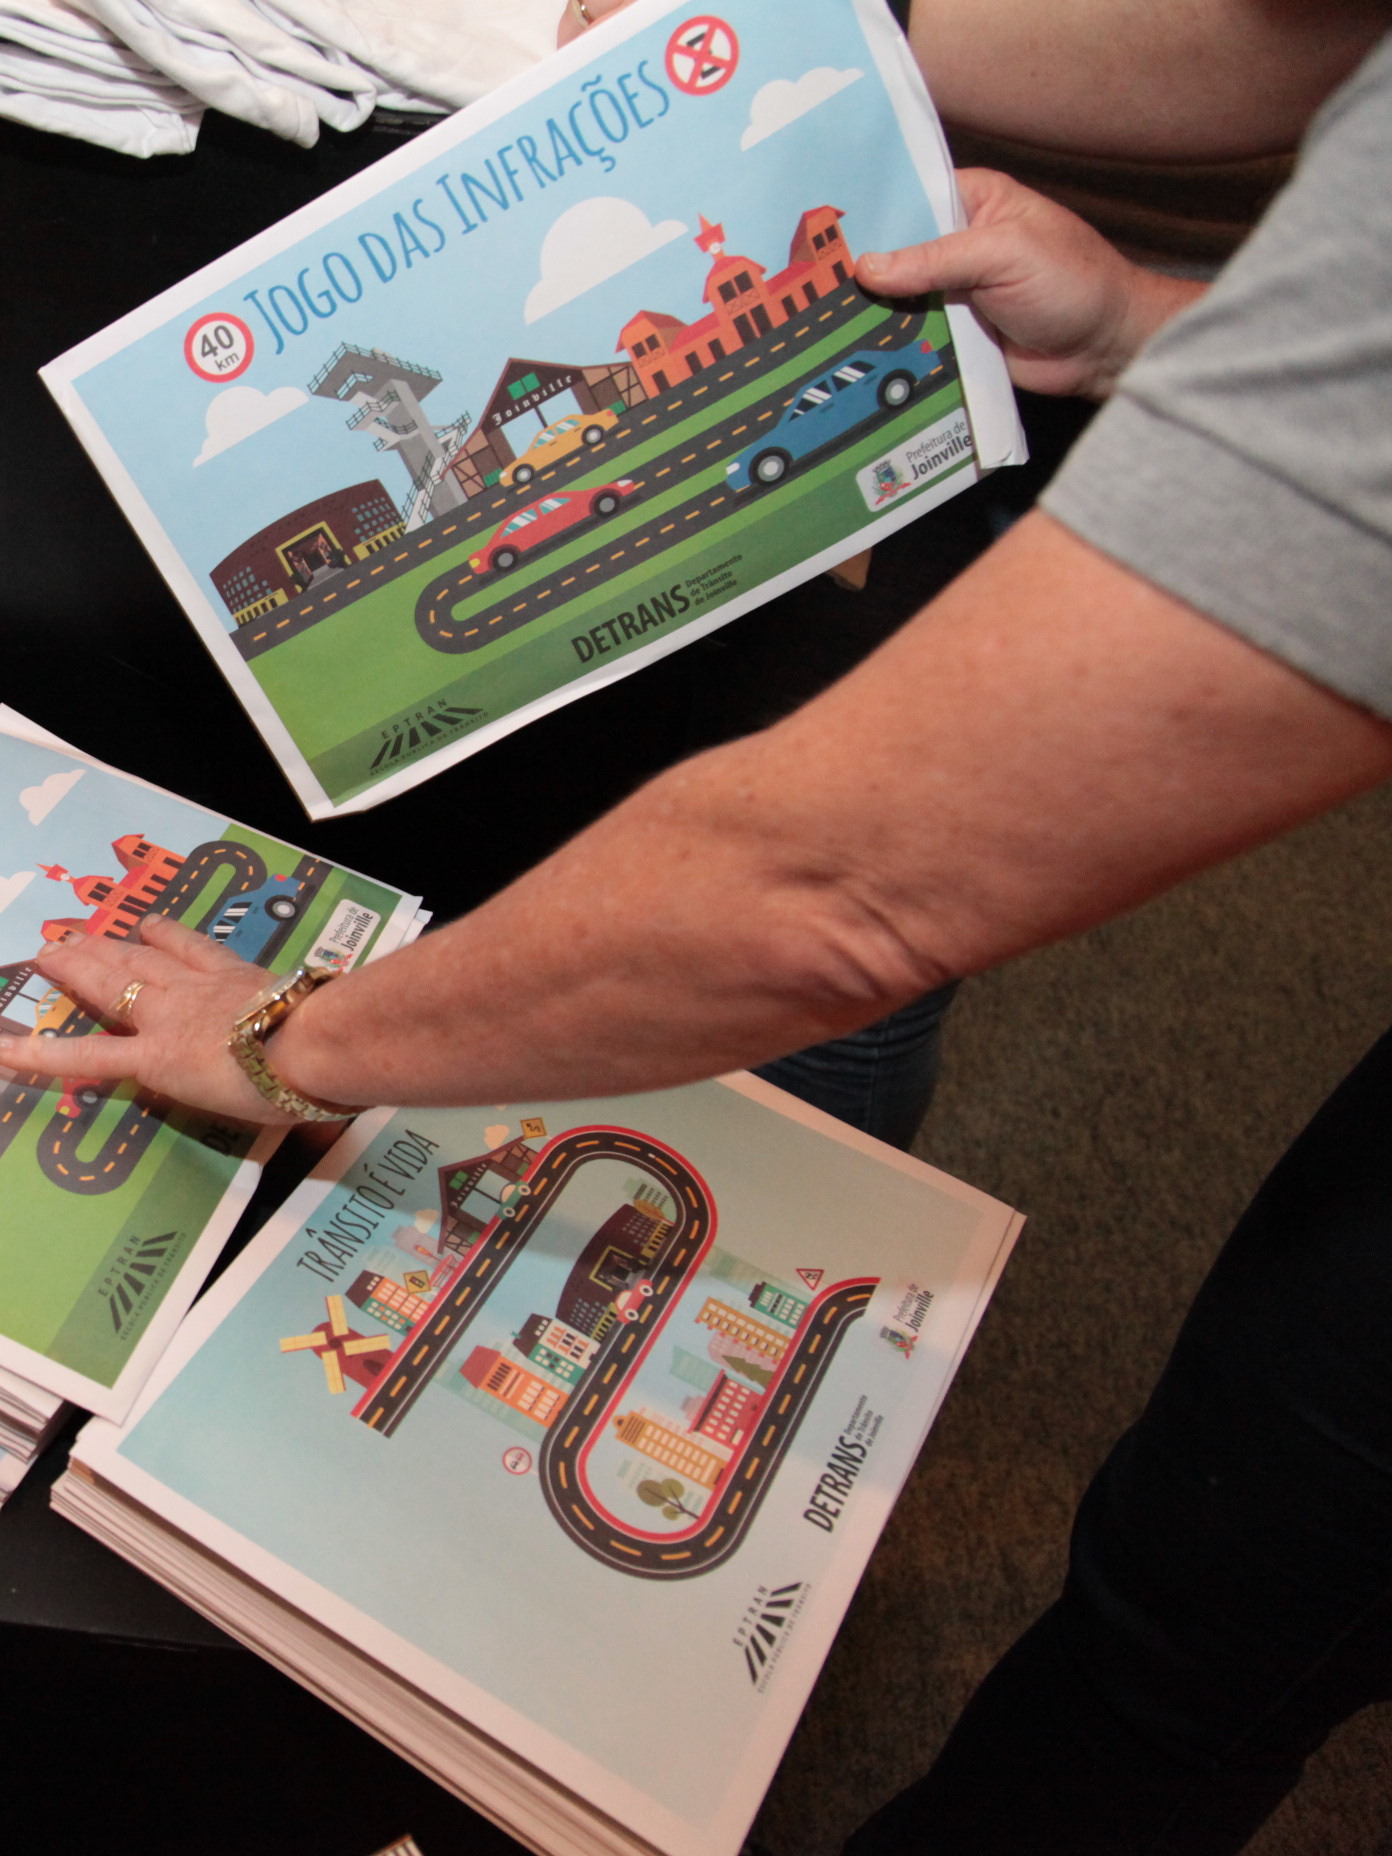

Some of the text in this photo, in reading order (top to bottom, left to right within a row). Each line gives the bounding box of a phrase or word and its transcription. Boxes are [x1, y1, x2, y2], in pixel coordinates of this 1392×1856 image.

[243, 60, 670, 355] JOGO DAS INFRAÇÕES
[200, 324, 235, 359] 40
[214, 350, 240, 372] km
[906, 420, 967, 463] Prefeitura de
[911, 434, 973, 480] Joinville
[685, 554, 743, 588] Departamento
[690, 571, 733, 597] de Trânsito
[695, 579, 737, 606] de Joinville
[570, 584, 691, 664] DETRANS
[381, 698, 447, 739] EPTRAN
[329, 906, 359, 944] Prefeitura de
[340, 911, 374, 952] Joinville
[296, 1128, 441, 1283] TRÂNSITO É VIDA
[97, 1234, 141, 1297] EPTRAN
[904, 1289, 935, 1333] Joinville
[802, 1435, 867, 1534] DETRANS
[733, 1585, 768, 1647] EPTRAN
